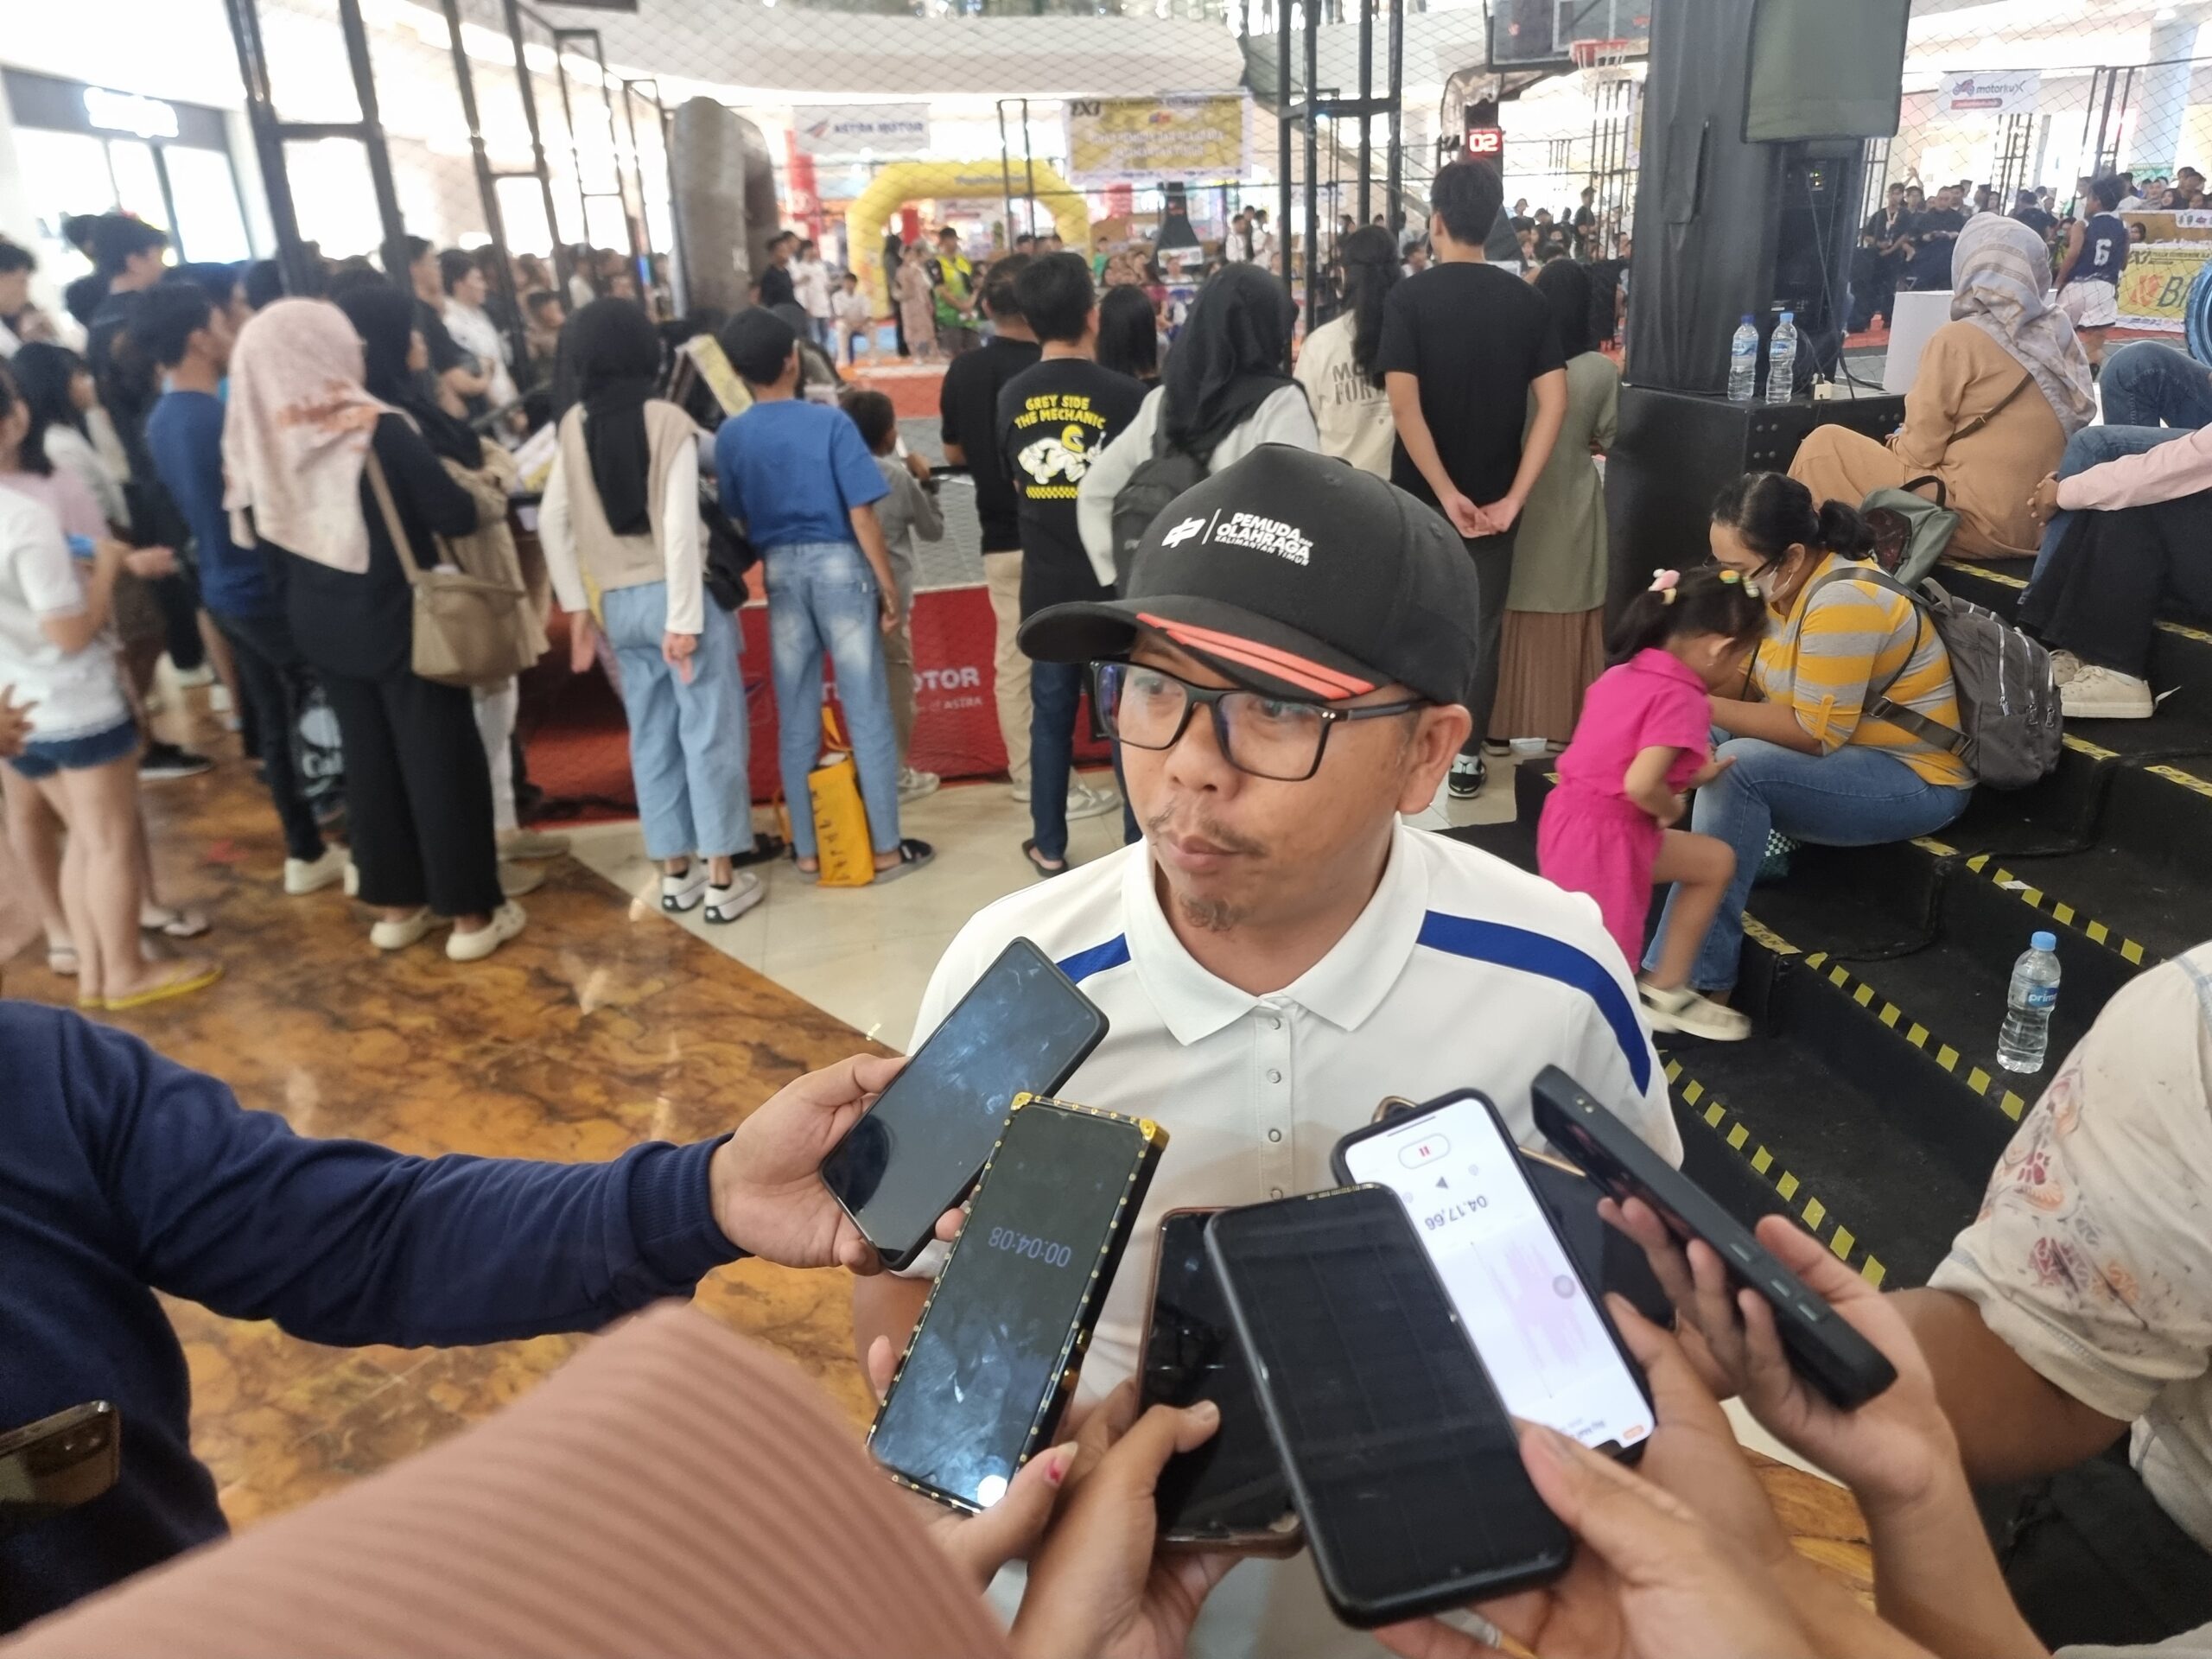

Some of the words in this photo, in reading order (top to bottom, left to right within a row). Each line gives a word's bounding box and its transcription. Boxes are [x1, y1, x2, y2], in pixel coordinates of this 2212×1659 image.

[1469, 133, 1498, 152] 02
[2094, 238, 2112, 266] 6
[1025, 394, 1059, 410] GREY
[1061, 394, 1090, 410] SIDE
[1014, 410, 1038, 429] THE
[1039, 408, 1107, 429] MECHANIC
[1217, 523, 1310, 560] OLAHRAGA
[1230, 512, 1300, 542] PEMUDA
[1214, 535, 1276, 554] KALIMANTAN
[1277, 549, 1309, 567] TIMUR
[988, 1226, 1071, 1268] 00:04:08
